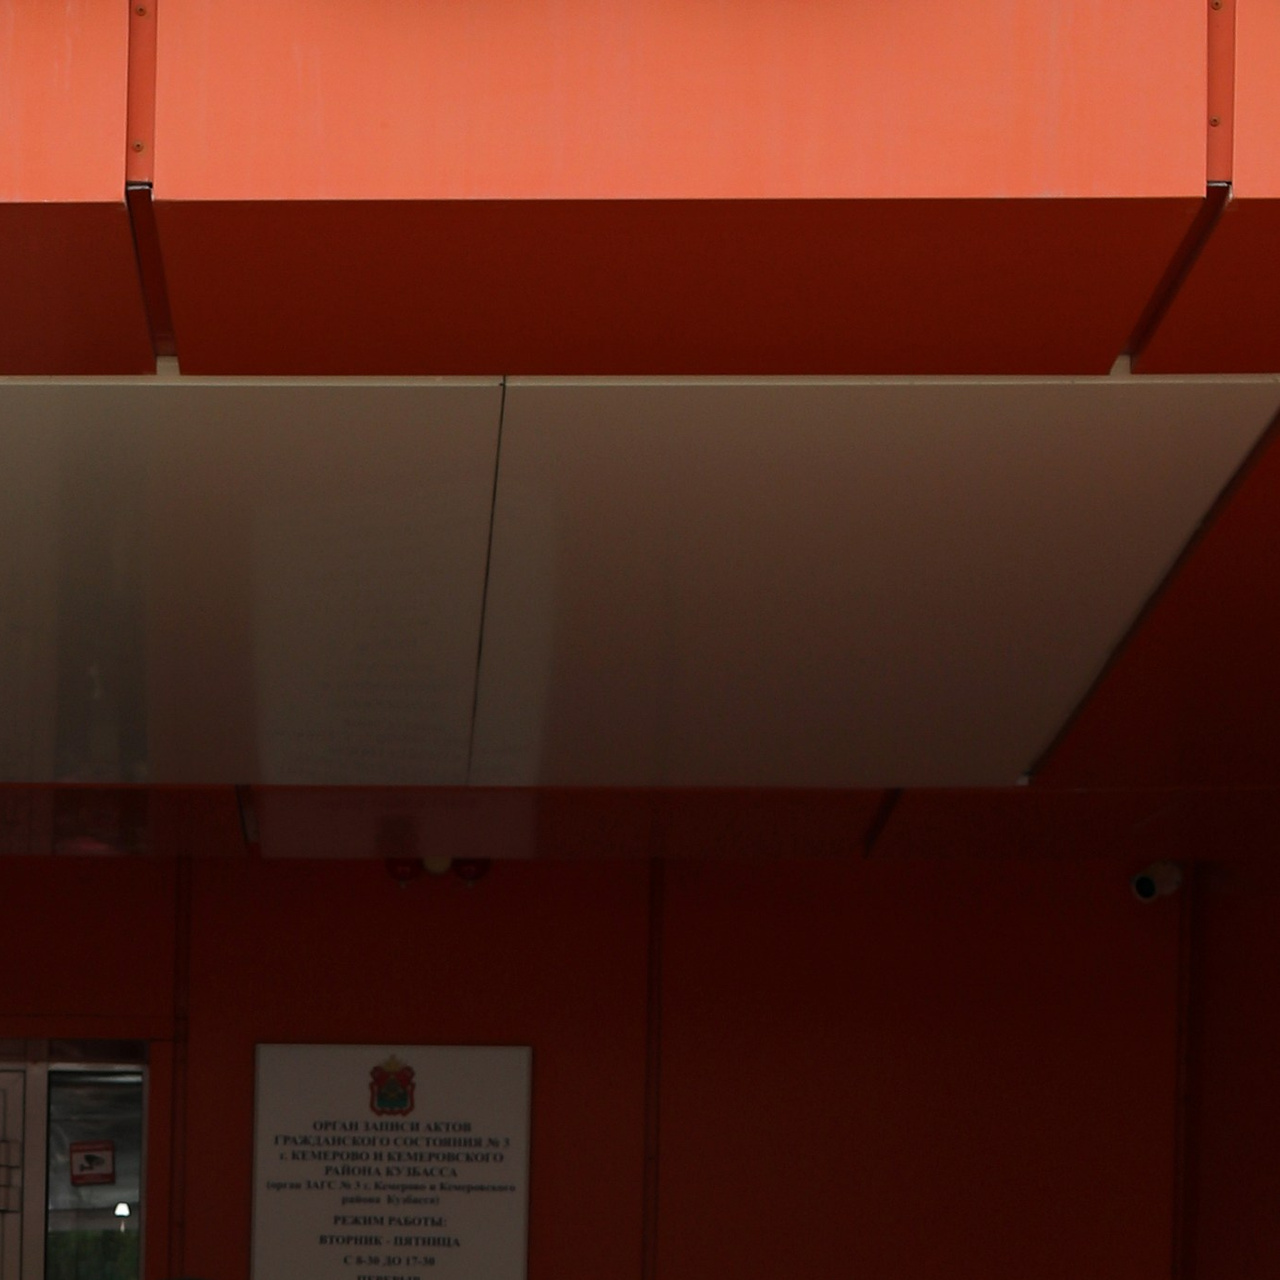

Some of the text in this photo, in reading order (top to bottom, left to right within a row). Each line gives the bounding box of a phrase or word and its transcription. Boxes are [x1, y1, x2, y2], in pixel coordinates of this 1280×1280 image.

[313, 1121, 472, 1133] ОРГАН ЗАПИСИ АКТОВ
[274, 1135, 389, 1147] ГРАЖДАНСКОГО
[393, 1136, 482, 1148] СОСТОЯНИЯ
[291, 1150, 370, 1162] КЕМЕРОВО
[387, 1151, 504, 1163] КЕМЕРОВСКОГО
[324, 1165, 457, 1178] РАЙОНА КУЗБАССА
[305, 1180, 334, 1190] ЗАГС
[373, 1181, 426, 1192] Кемерово
[439, 1182, 516, 1193] Кемеровского
[333, 1215, 447, 1228] РЕЖИМ РАБОТЫ:
[319, 1235, 382, 1246] ВТОРНИК
[393, 1236, 460, 1249] ПЯТНИЦА
[383, 1256, 402, 1268] ДО
